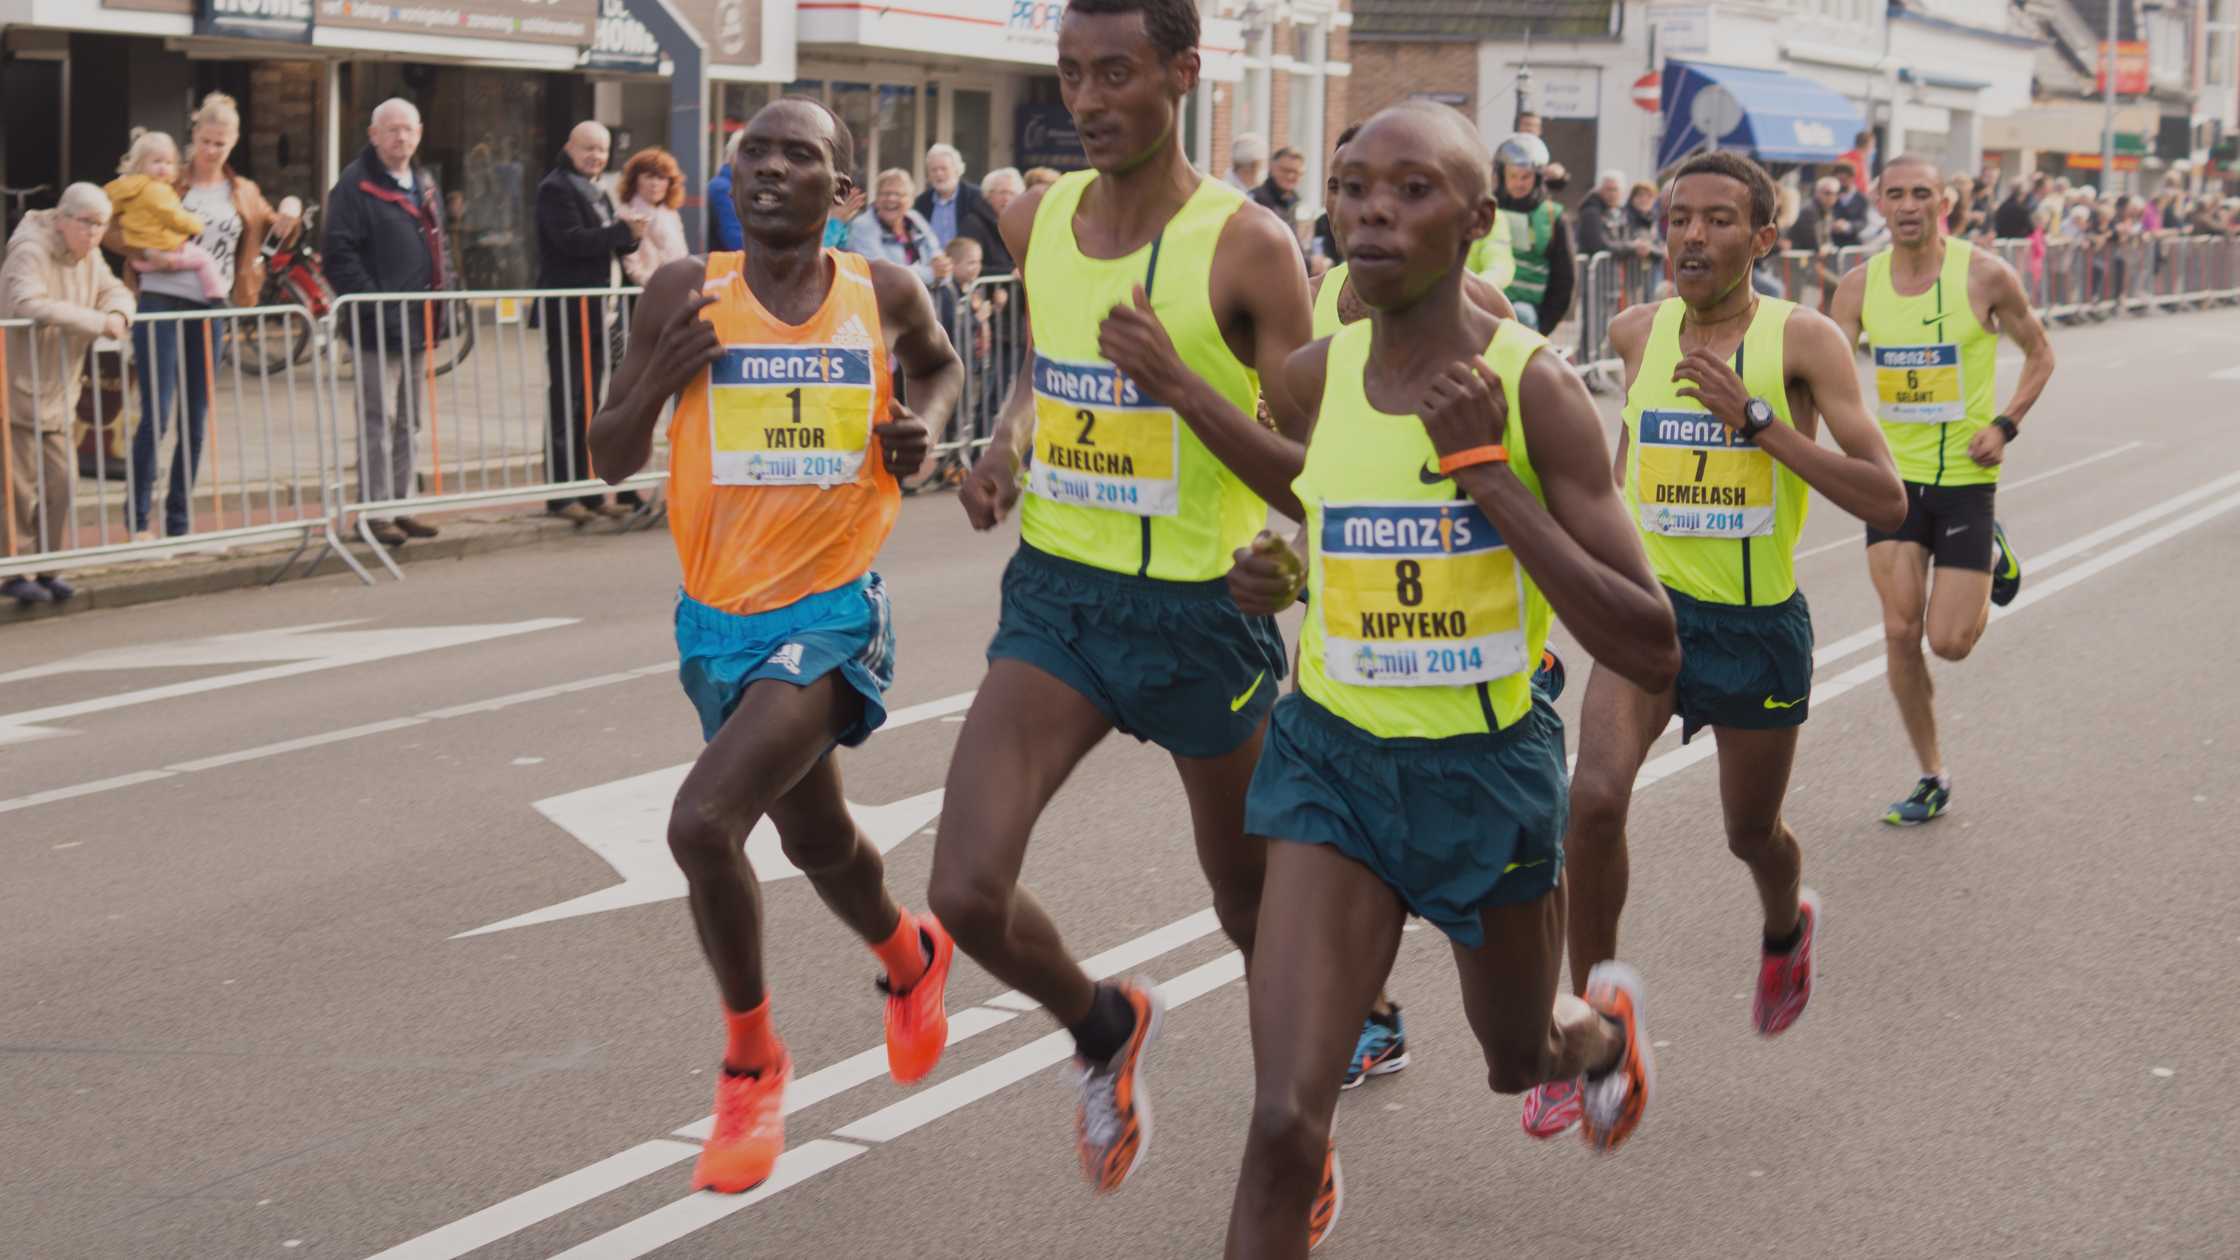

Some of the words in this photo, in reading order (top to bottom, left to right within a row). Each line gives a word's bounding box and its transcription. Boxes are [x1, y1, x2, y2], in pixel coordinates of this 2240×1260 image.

[742, 349, 844, 383] menzis
[1907, 369, 1918, 389] 6
[1045, 367, 1139, 407] menzis
[786, 388, 801, 423] 1
[764, 427, 825, 449] YATOR
[1076, 409, 1095, 446] 2
[803, 456, 842, 475] 2014
[1693, 450, 1708, 482] 7
[1096, 481, 1138, 504] 2014
[1656, 484, 1746, 505] DEMELASH
[1344, 506, 1472, 552] menzis
[1706, 512, 1744, 530] 2014
[1395, 559, 1424, 607] 8
[1361, 611, 1467, 639] KIPYEKO
[1426, 646, 1483, 673] 2014
